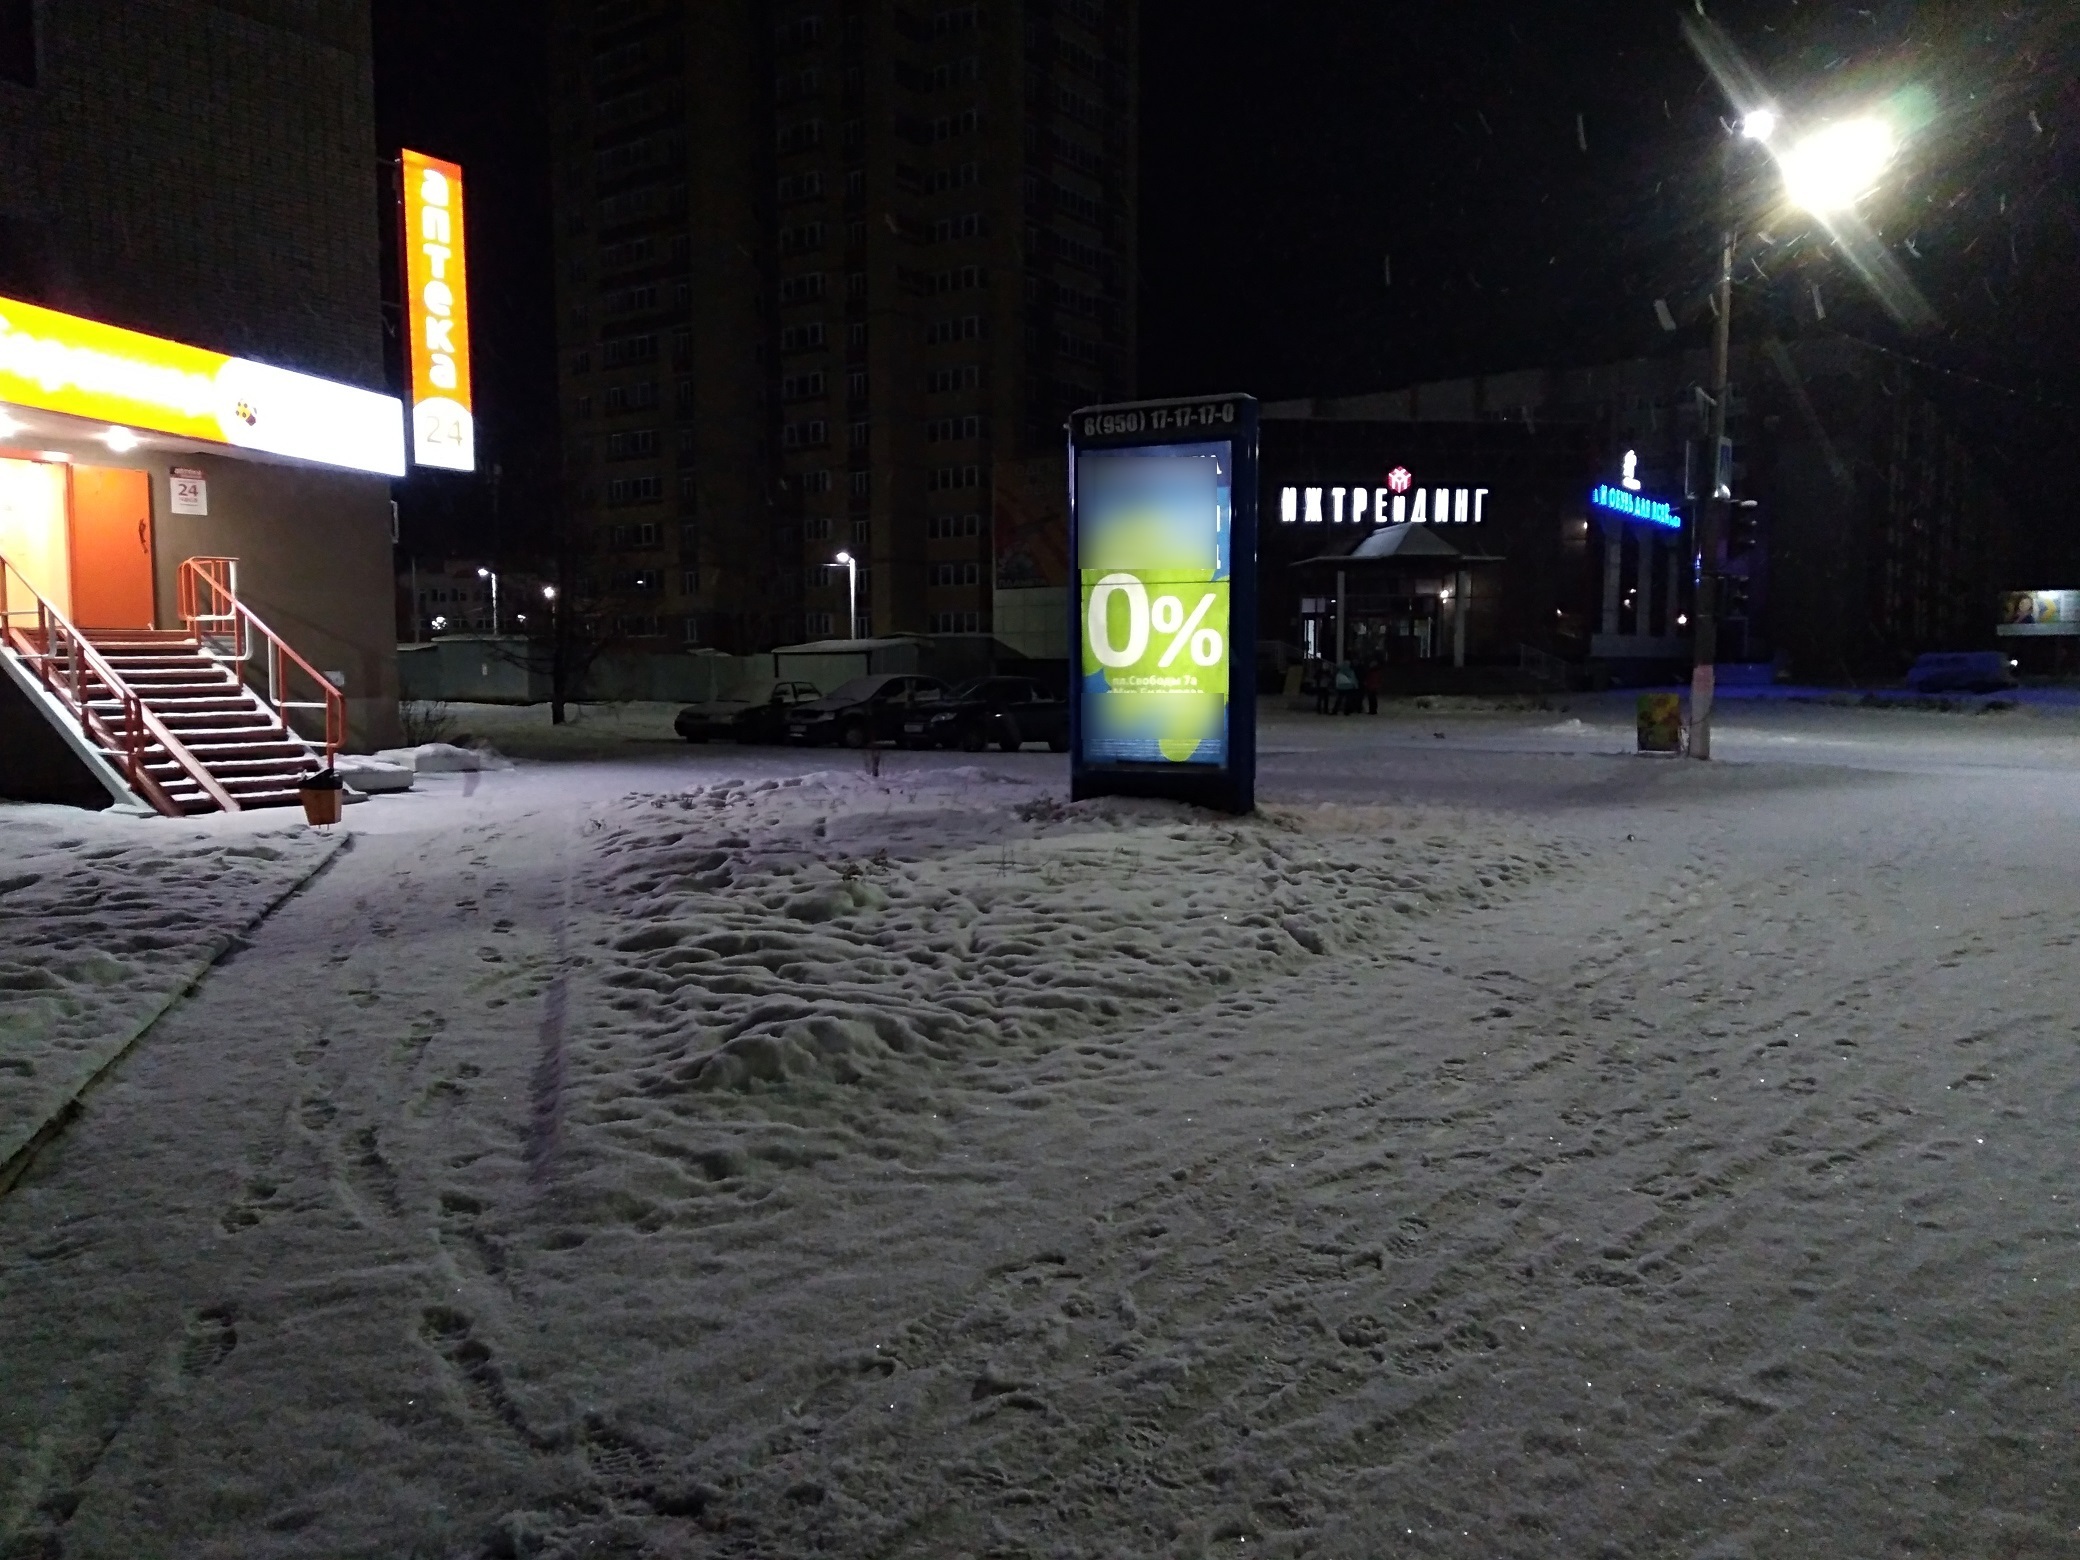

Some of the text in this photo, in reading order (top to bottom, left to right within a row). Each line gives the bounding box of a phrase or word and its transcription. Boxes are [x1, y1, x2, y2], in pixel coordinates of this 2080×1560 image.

[420, 168, 457, 390] аптека
[424, 415, 463, 446] 24
[1084, 403, 1235, 437] 8(950) 17-17-17-0
[178, 483, 199, 497] 24
[1088, 573, 1223, 668] 0%
